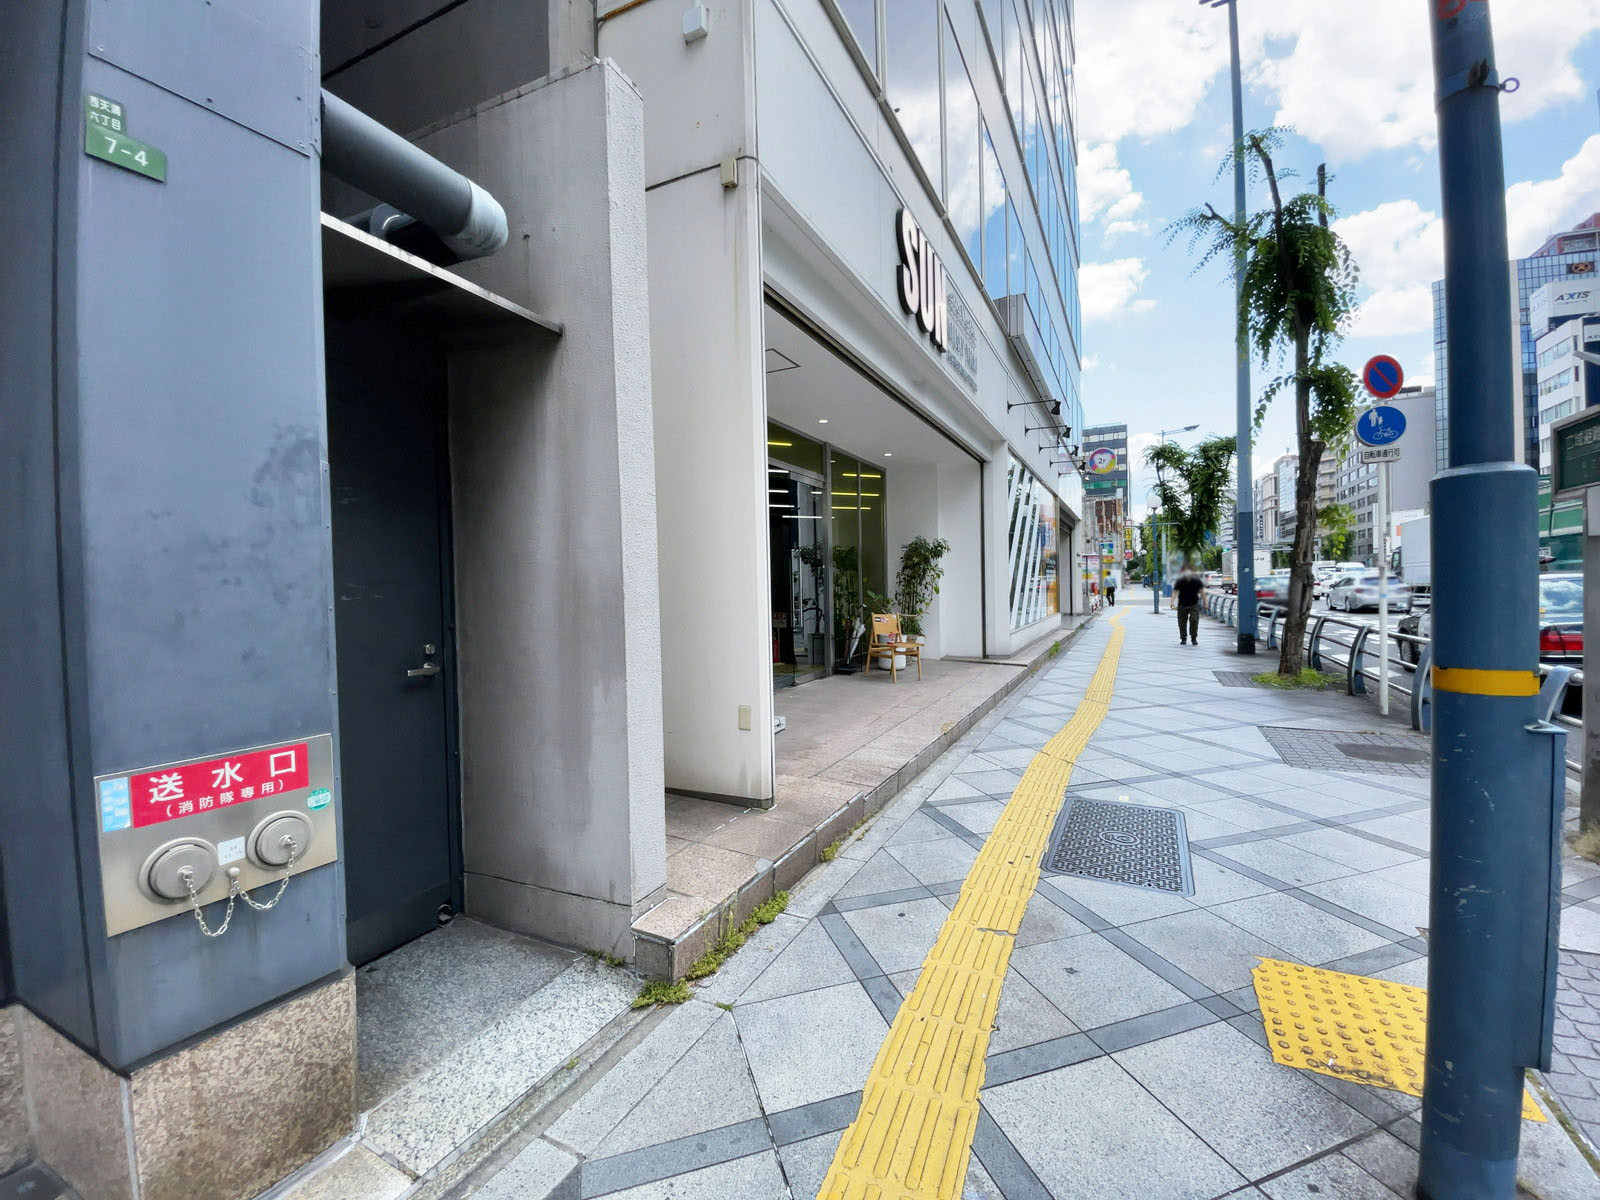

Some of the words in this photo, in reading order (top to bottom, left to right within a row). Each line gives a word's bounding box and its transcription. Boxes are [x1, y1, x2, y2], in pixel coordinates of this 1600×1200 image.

[90, 111, 121, 131] 六丁目
[104, 136, 148, 167] 7-4
[896, 207, 947, 353] SUN
[1555, 290, 1591, 302] AXIS
[1364, 447, 1400, 460] 自転車通行可
[149, 750, 297, 804] 送水口
